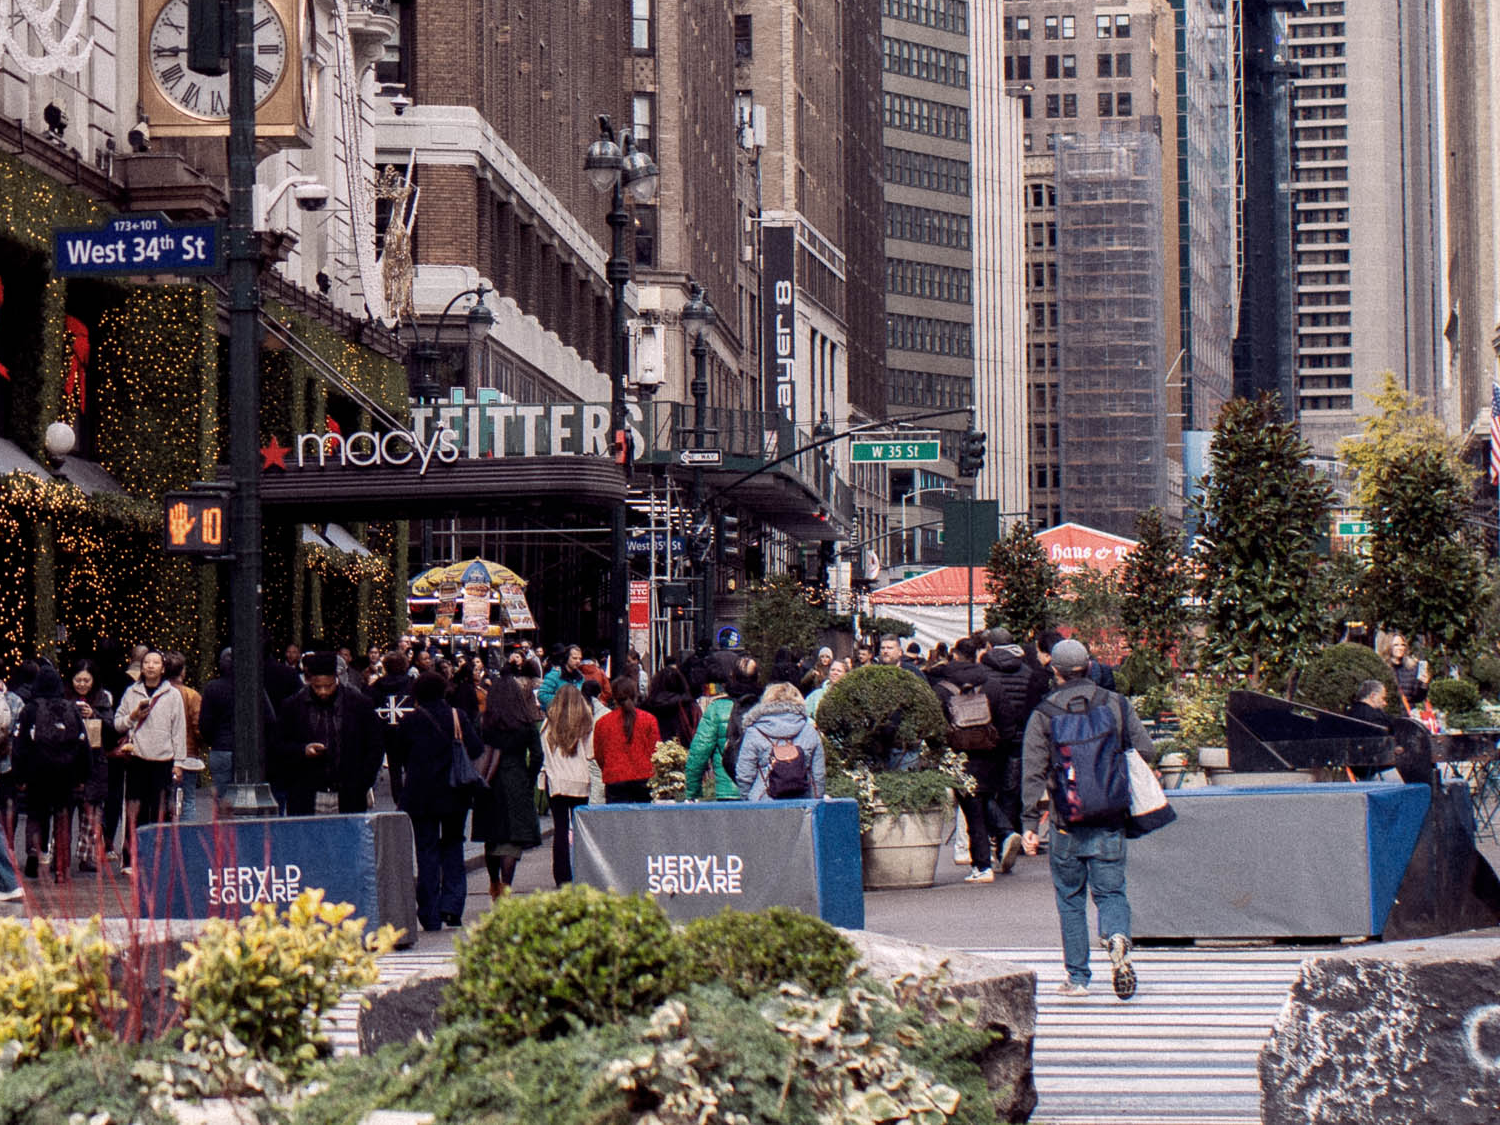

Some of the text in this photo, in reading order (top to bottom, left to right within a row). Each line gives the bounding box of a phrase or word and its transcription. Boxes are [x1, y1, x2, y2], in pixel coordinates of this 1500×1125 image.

[113, 220, 157, 232] 173 101
[66, 234, 206, 265] West 34th St
[871, 444, 919, 458] W 35 St
[200, 506, 223, 545] 10
[626, 540, 650, 551] West
[671, 540, 682, 551] St
[208, 883, 300, 905] SQUARE
[648, 873, 742, 894] SQUARE
